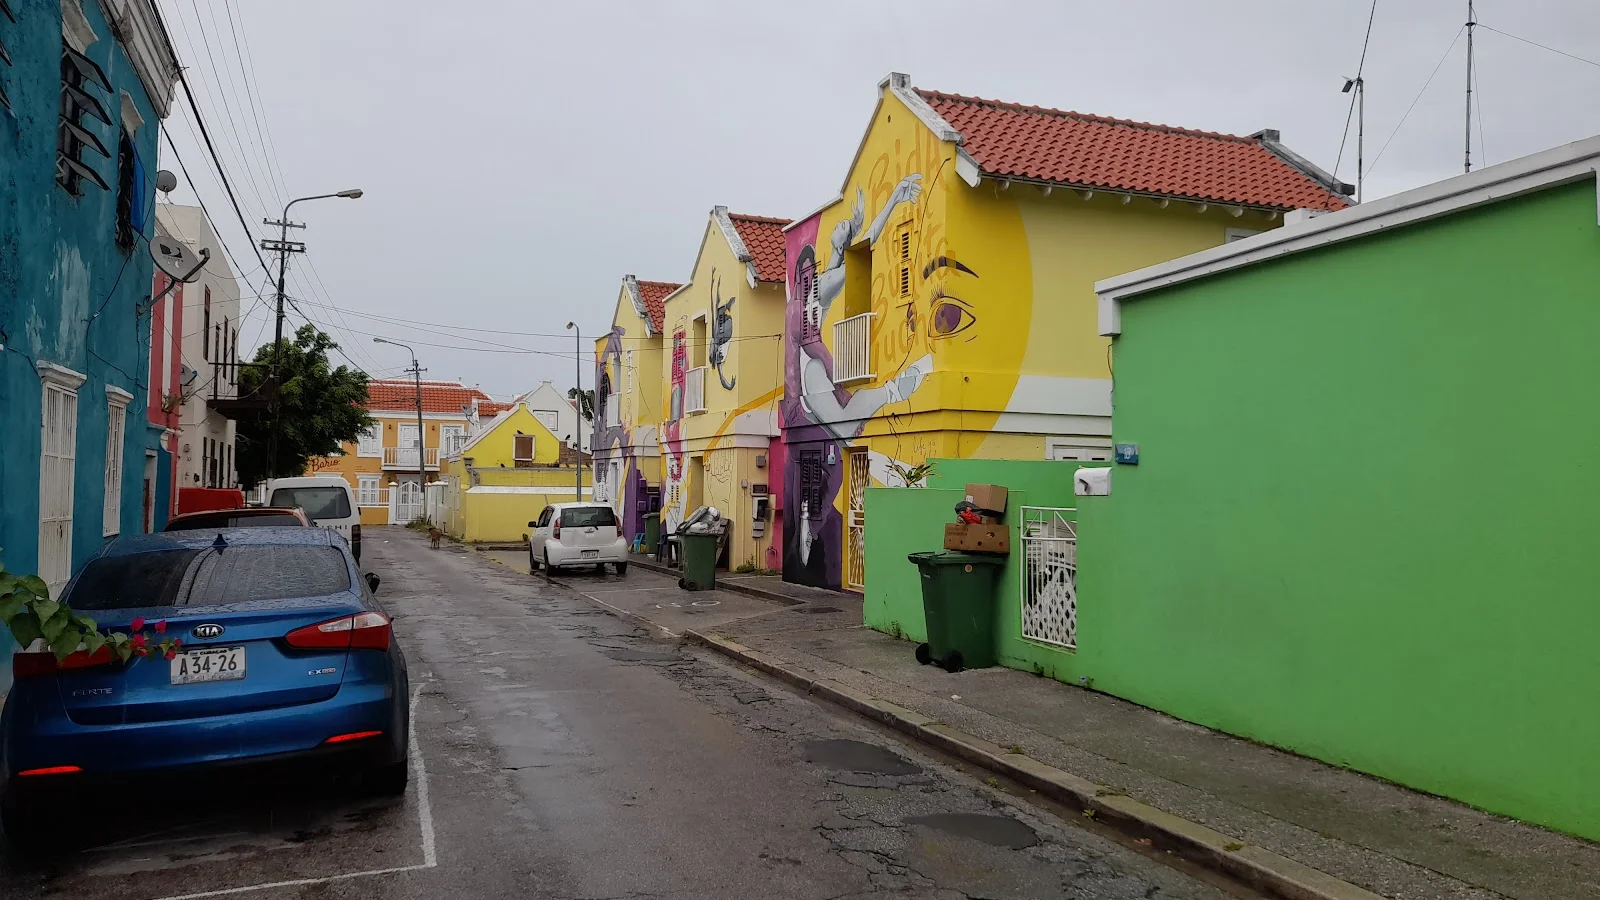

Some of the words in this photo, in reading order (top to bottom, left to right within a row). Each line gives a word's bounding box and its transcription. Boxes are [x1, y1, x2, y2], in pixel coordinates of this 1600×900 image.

[196, 625, 219, 638] KIA
[180, 657, 188, 675] A
[192, 654, 237, 673] 34-26
